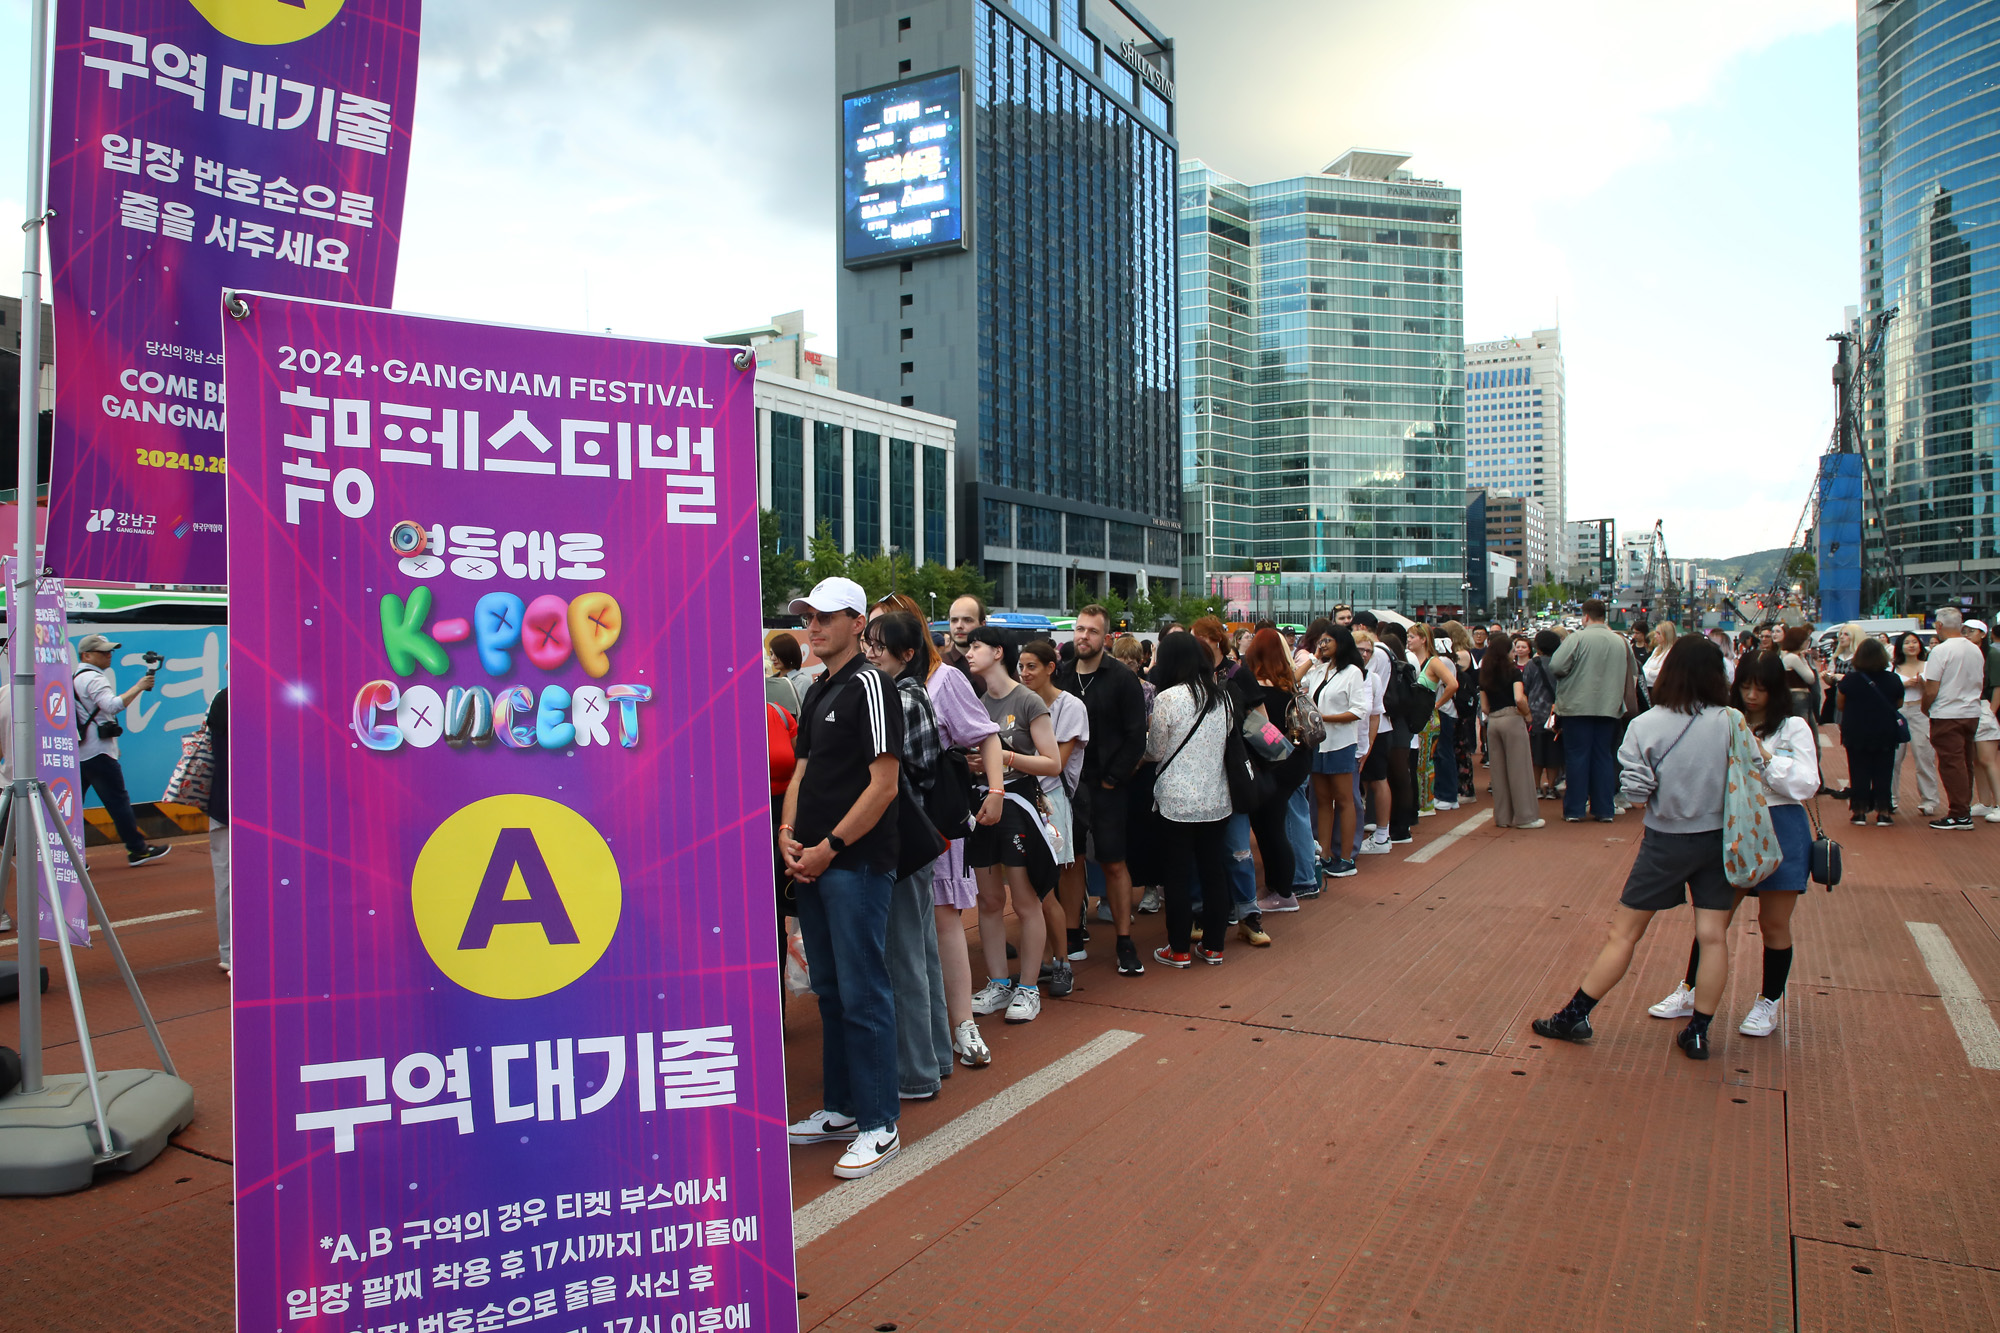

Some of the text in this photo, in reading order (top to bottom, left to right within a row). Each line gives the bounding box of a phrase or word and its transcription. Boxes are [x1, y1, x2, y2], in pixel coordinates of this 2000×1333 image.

[84, 26, 391, 155] 구역 대기줄
[1121, 40, 1175, 99] SHILLA STAY
[101, 134, 374, 228] 입장 번호순으로
[1387, 187, 1450, 200] PARK HYATT
[120, 190, 349, 273] 줄을 서주세요
[146, 341, 182, 359] 당신의
[184, 347, 204, 364] 강남
[1473, 341, 1509, 353] KT&G
[102, 394, 224, 432] GANGNA
[120, 368, 198, 400] COME
[570, 378, 715, 409] FESTIVAL
[117, 512, 157, 528] 강남구
[390, 520, 606, 581] 영동대로
[1255, 561, 1280, 571] 출입구
[1259, 575, 1276, 584] 3-5
[380, 585, 623, 679] K-POP
[352, 679, 653, 751] CONCERT
[457, 827, 580, 950] A
[296, 1025, 738, 1154] 구역 대기줄
[402, 1209, 490, 1248] 구역의
[498, 1198, 548, 1235] 경우
[556, 1191, 612, 1219] 티켓
[620, 1177, 728, 1215] 부스에서
[286, 1216, 758, 1321] 입장 팔찌 착용 후 17시까지 대기줄에
[417, 1264, 715, 1333] 번호순으로 줄을 서신 후
[670, 1302, 751, 1333] 이후에
